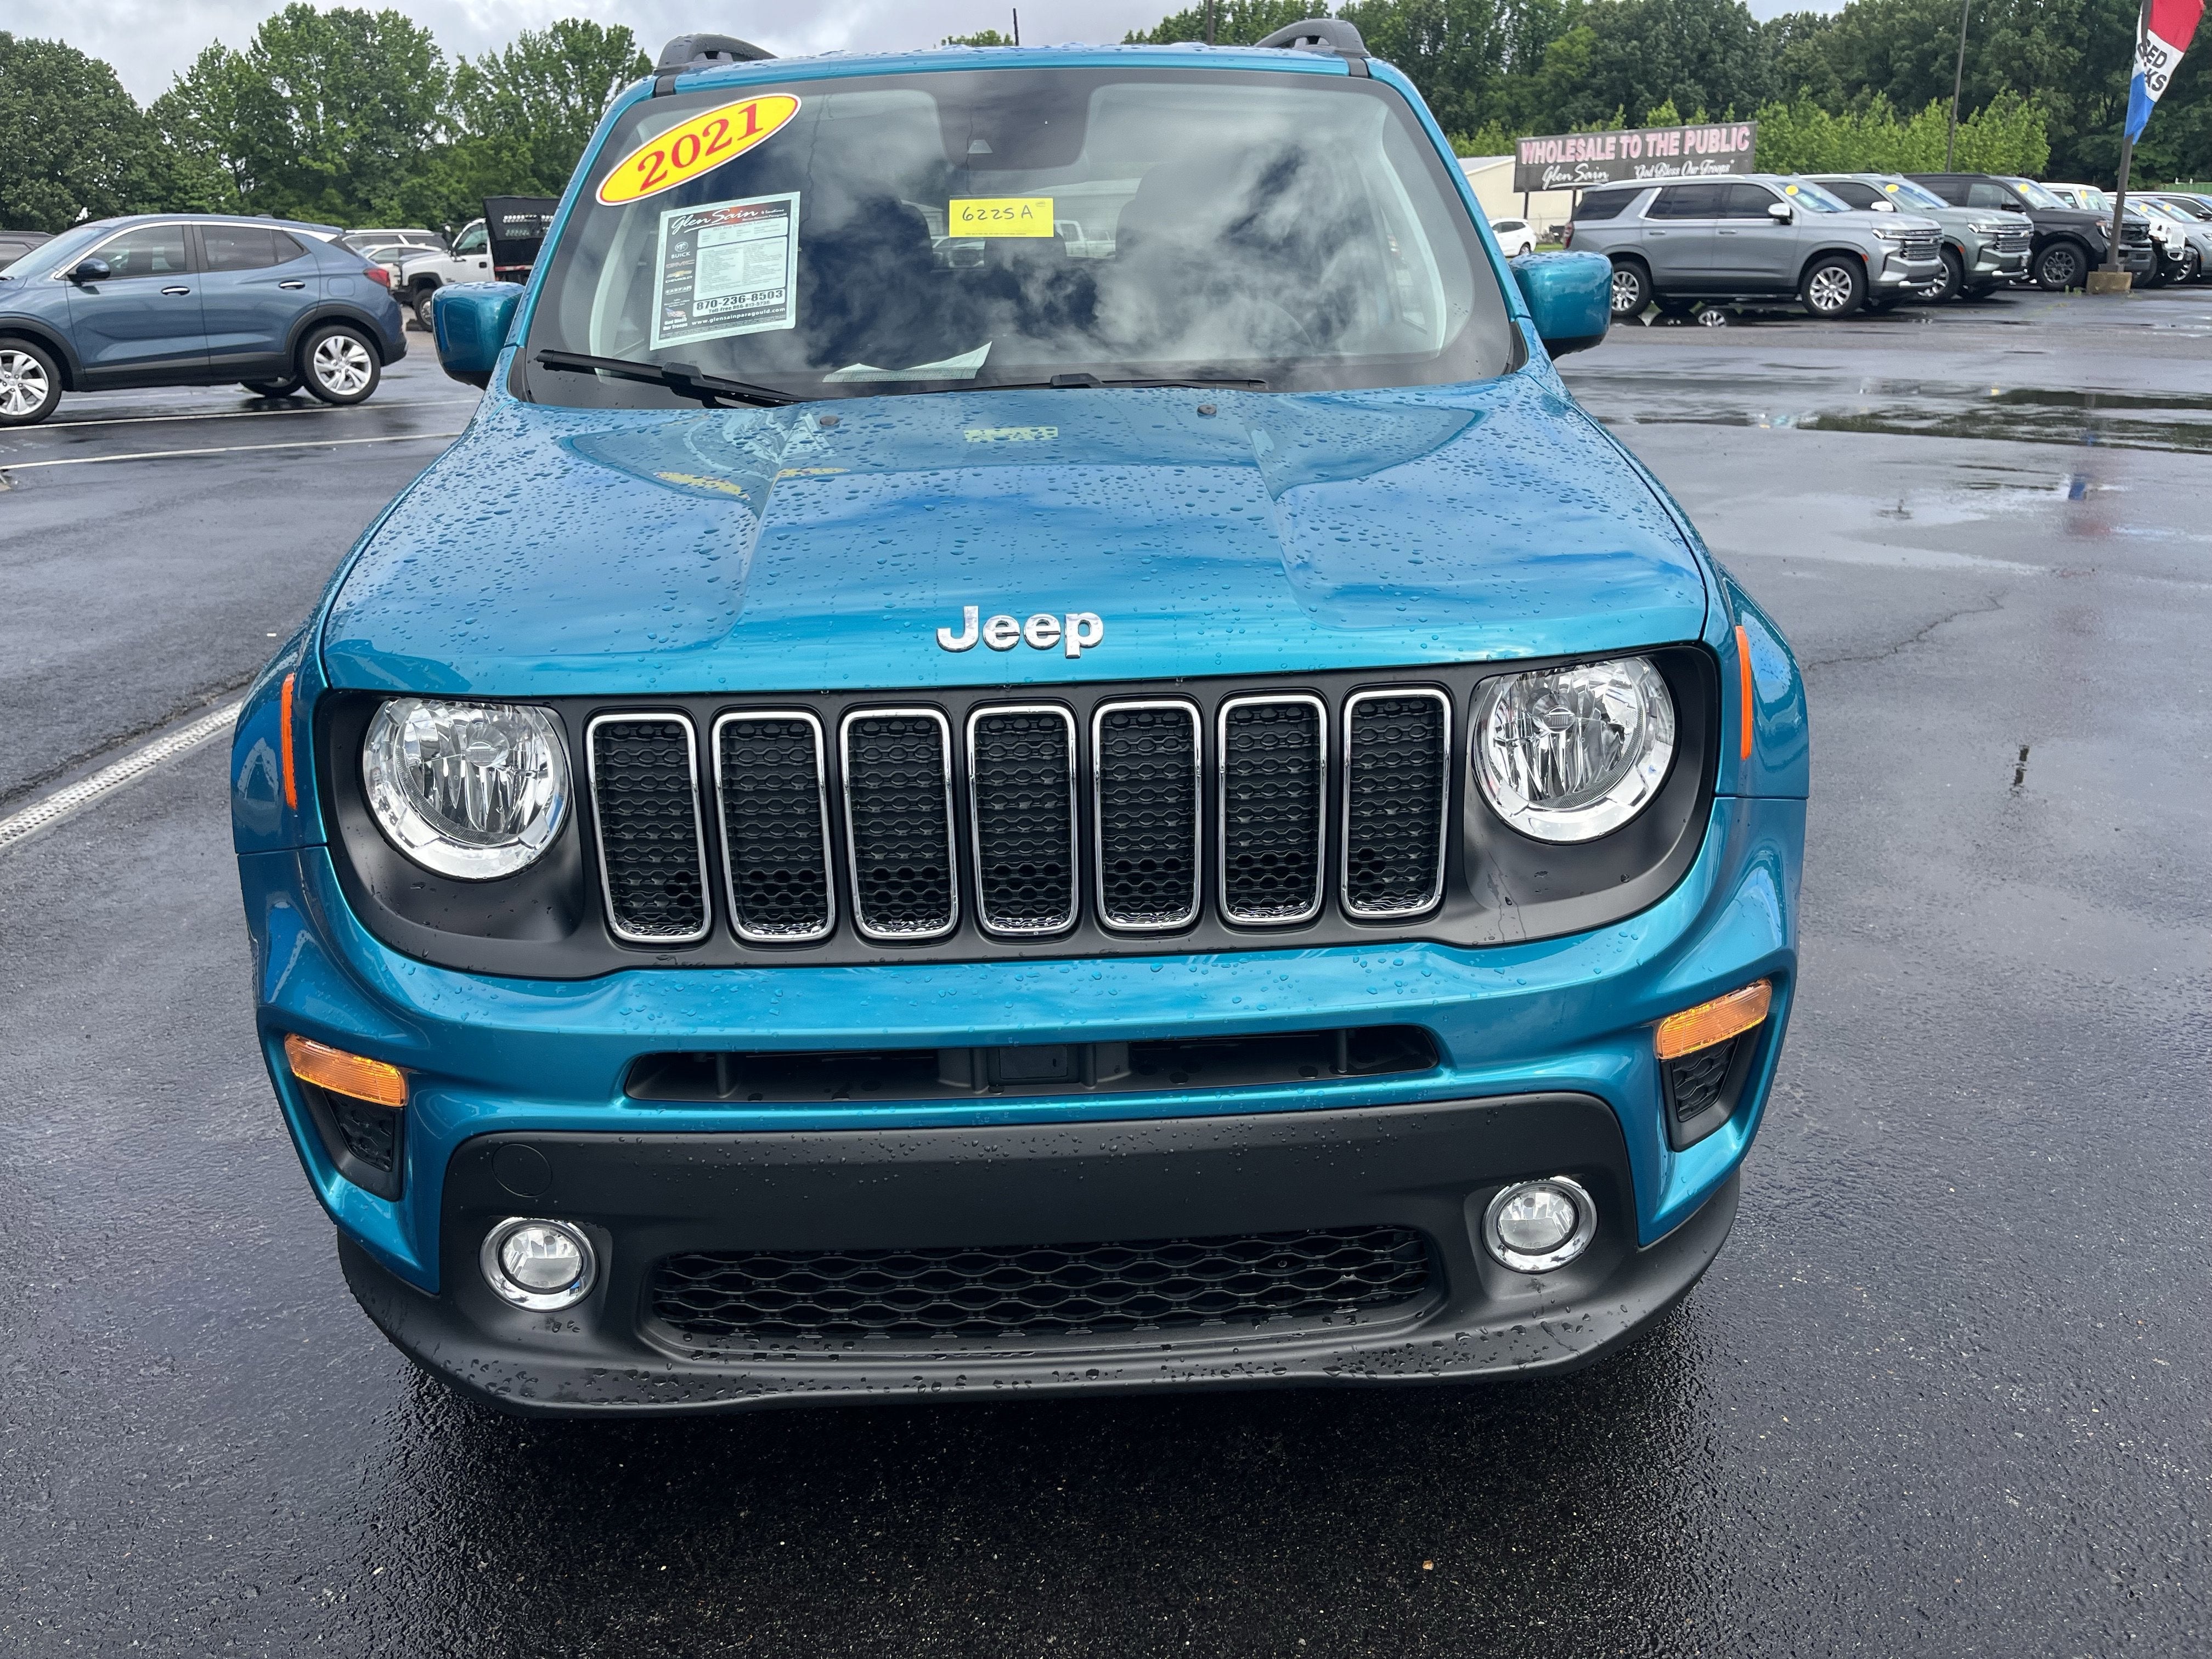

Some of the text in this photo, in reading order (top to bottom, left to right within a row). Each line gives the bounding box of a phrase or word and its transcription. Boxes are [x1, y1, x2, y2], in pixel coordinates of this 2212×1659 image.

[638, 103, 764, 192] 2021
[1521, 126, 1750, 165] WHOLESALE TO THE PUBLIC
[1542, 163, 1610, 190] Glen Sain
[671, 214, 712, 235] Glen
[711, 208, 760, 224] Sain
[665, 259, 696, 269] GMC
[671, 251, 691, 259] BUICK
[696, 290, 783, 310] 870-236-8503
[692, 307, 786, 325] www.glensainparagould.com
[936, 605, 1104, 659] Jeep
